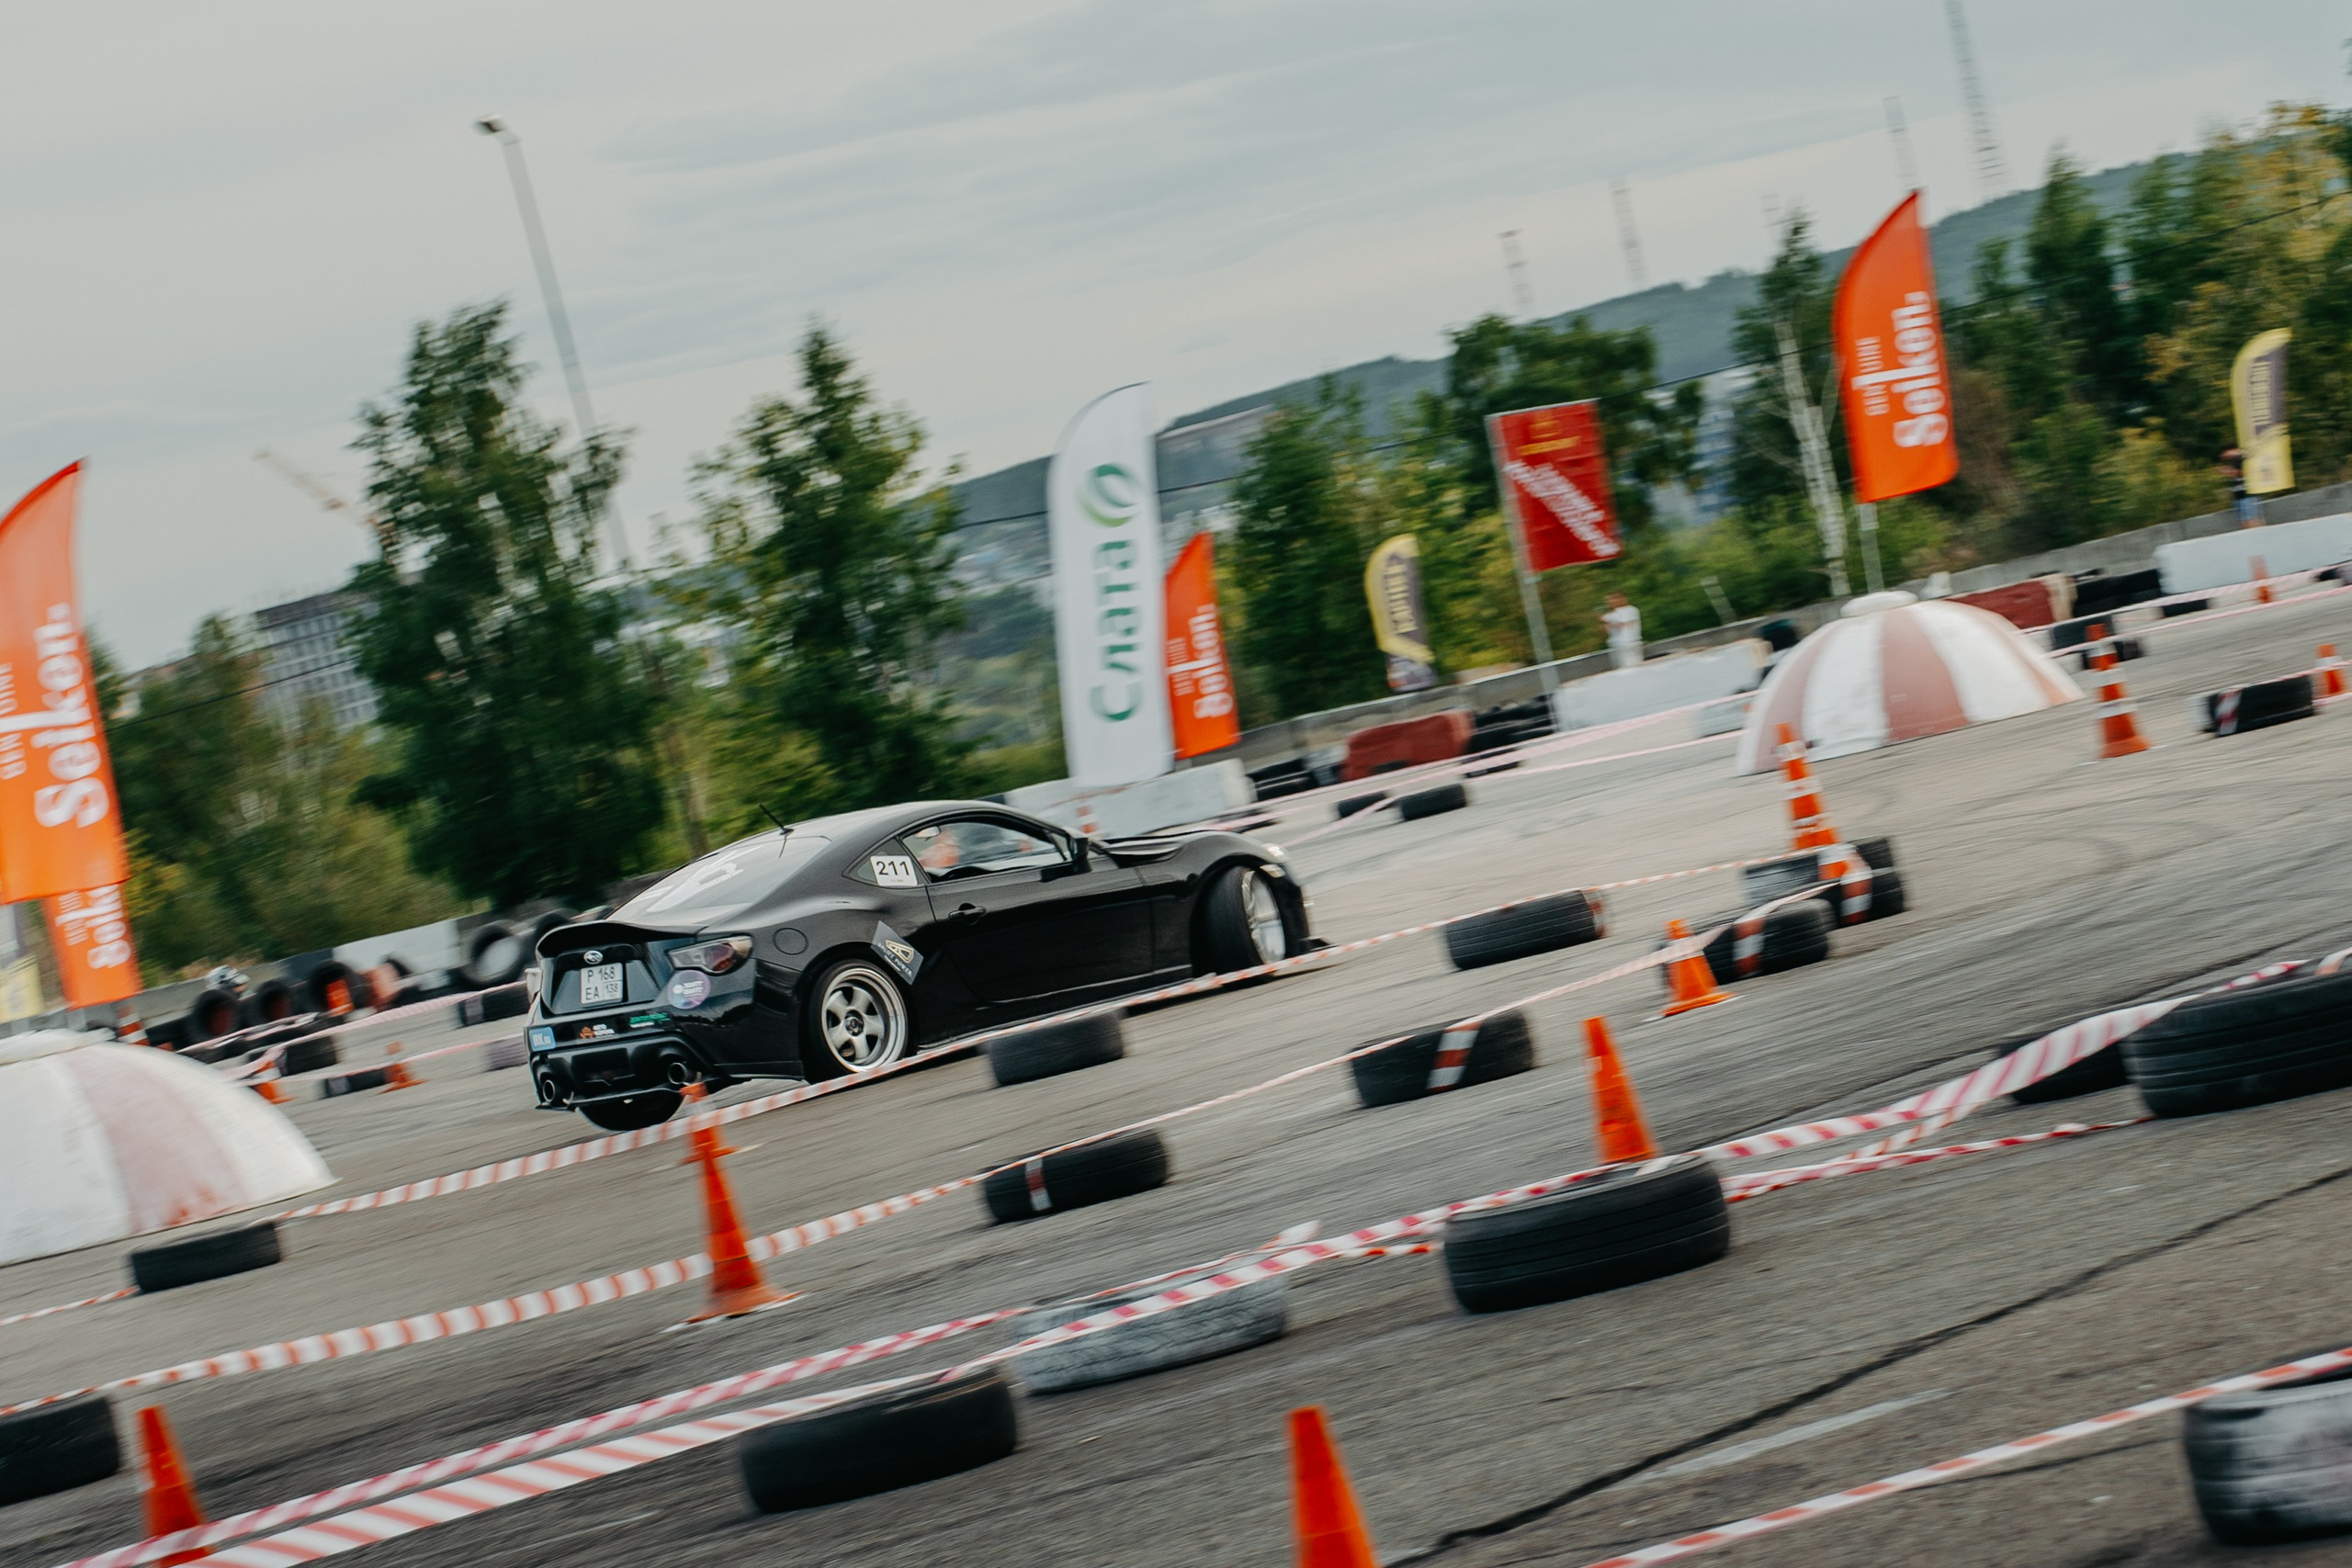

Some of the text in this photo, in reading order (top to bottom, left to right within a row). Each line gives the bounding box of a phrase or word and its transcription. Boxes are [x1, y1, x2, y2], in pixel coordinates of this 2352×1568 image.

[1091, 538, 1142, 722] Слата
[876, 861, 910, 876] 211
[598, 966, 616, 981] 168
